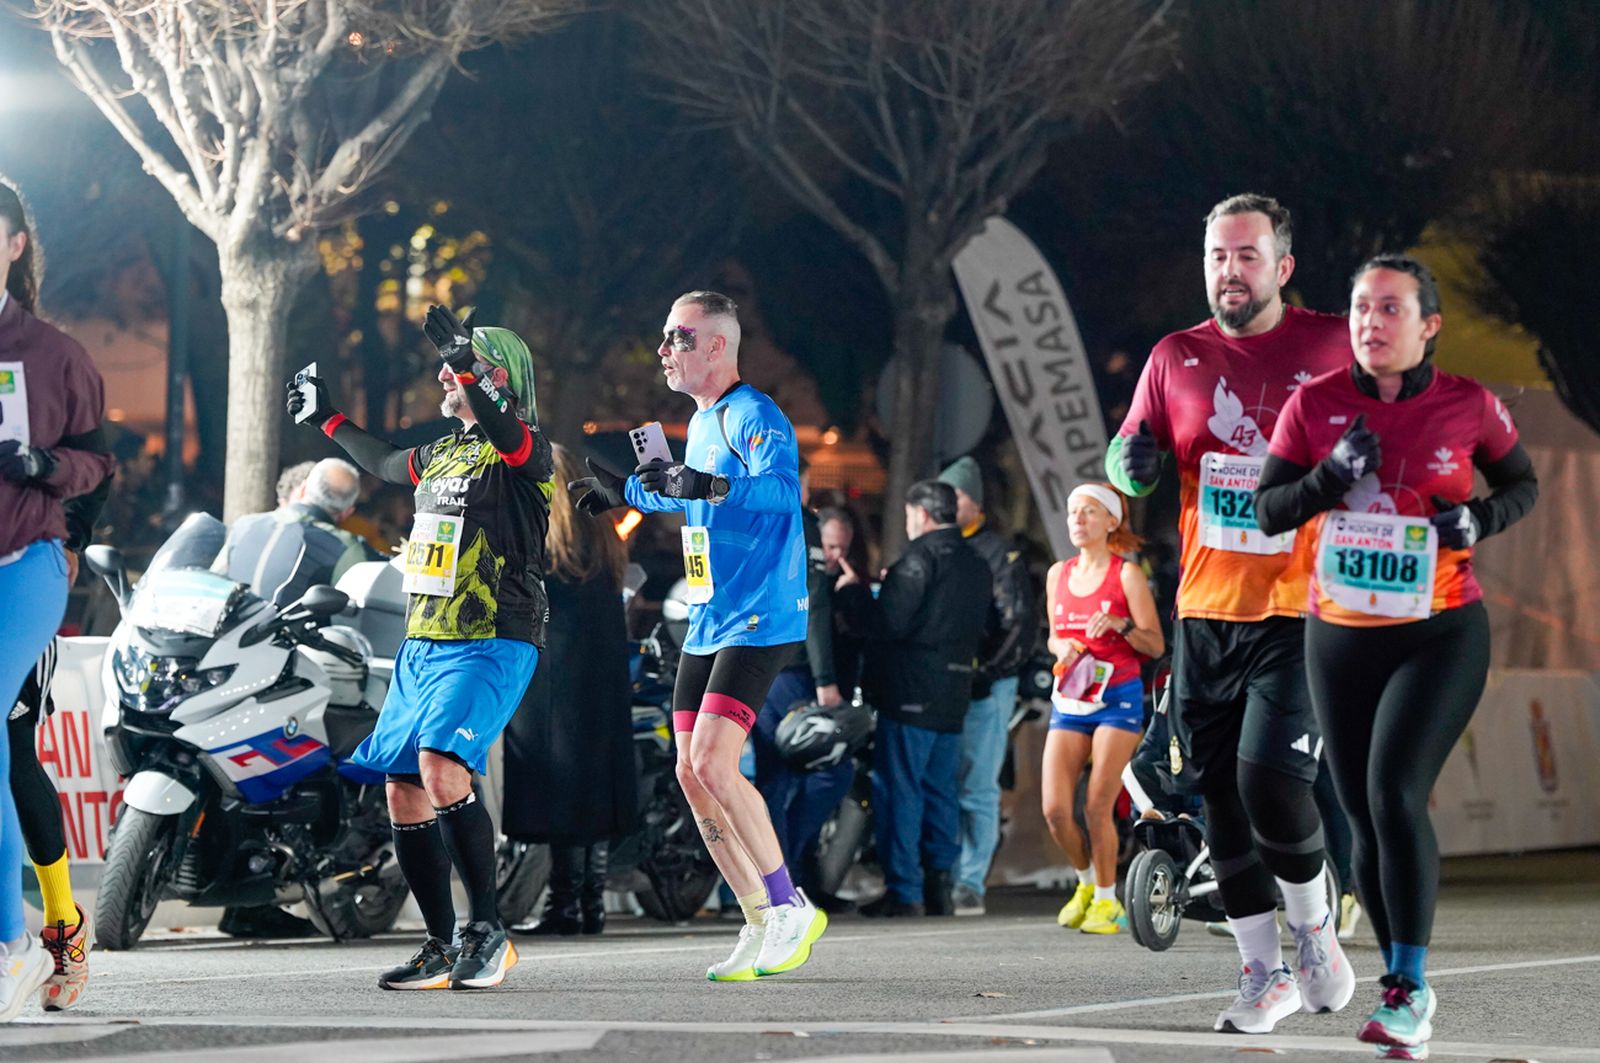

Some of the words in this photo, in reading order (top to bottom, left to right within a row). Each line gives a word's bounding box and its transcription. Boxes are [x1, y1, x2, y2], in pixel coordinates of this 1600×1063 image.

[1231, 425, 1257, 447] 43
[1209, 475, 1225, 486] SAN
[437, 496, 469, 507] TRAIL
[1211, 489, 1256, 520] 132
[686, 555, 704, 578] 45
[1336, 548, 1418, 583] 13108
[38, 710, 92, 778] AN
[58, 787, 125, 860] NT
